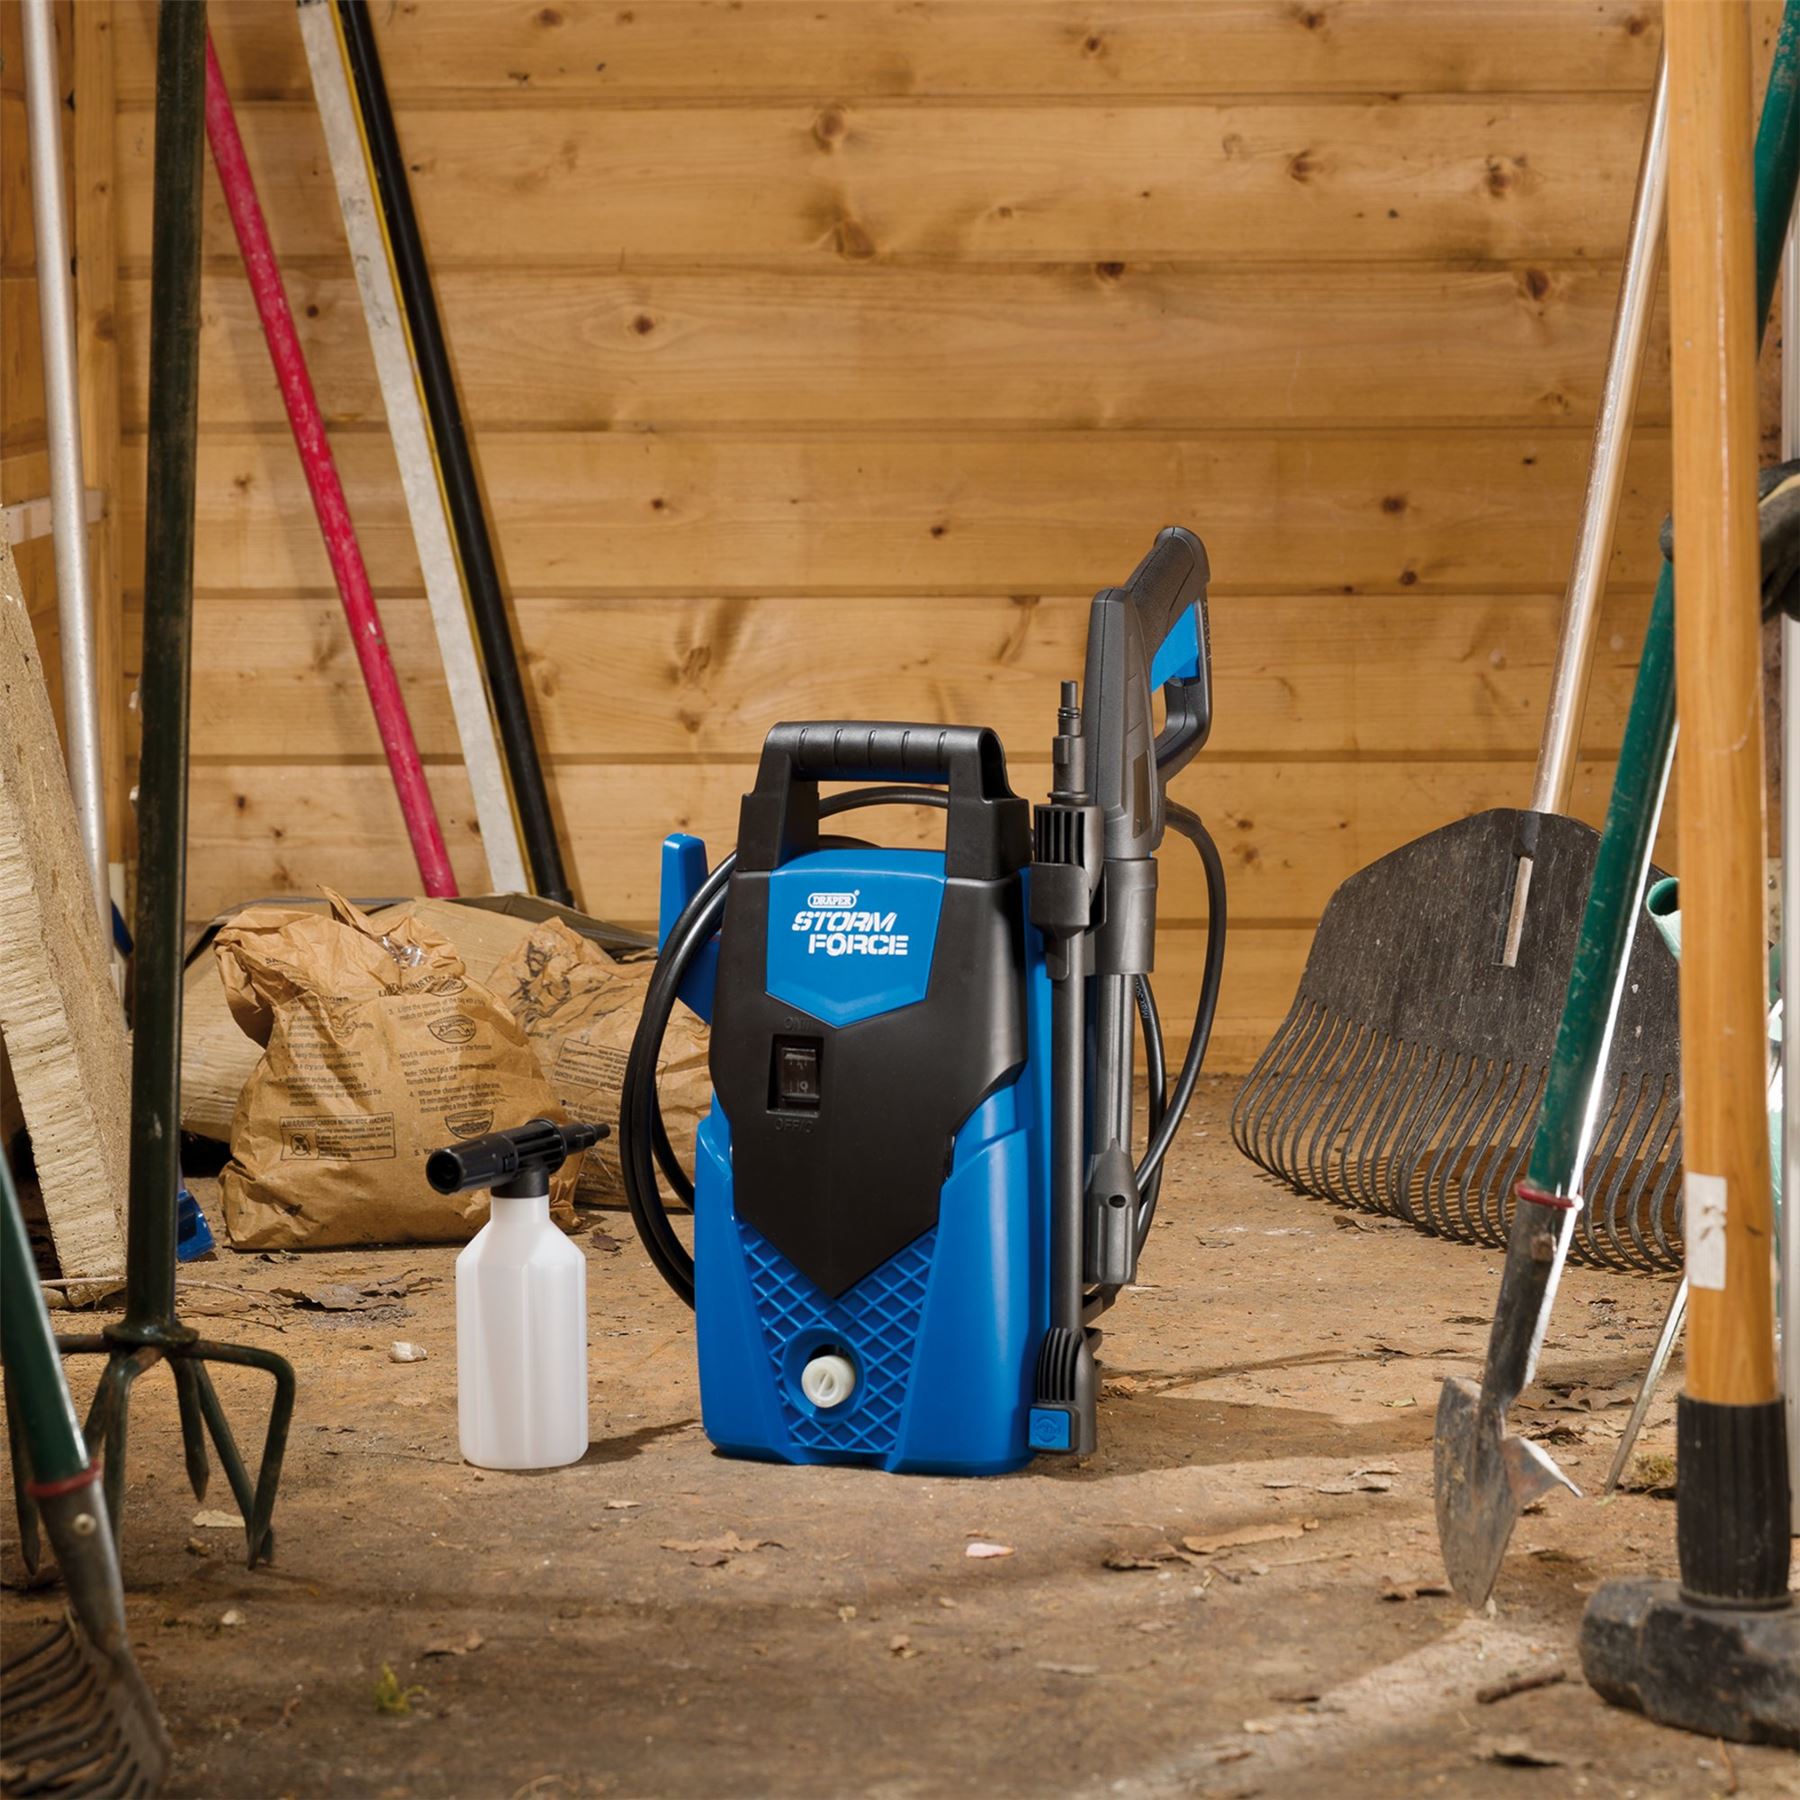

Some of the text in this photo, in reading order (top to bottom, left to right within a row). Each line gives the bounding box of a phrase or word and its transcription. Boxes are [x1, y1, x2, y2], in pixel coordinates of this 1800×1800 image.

[812, 895, 851, 905] DRAPER
[792, 911, 897, 932] STORM
[808, 933, 909, 956] FORCE
